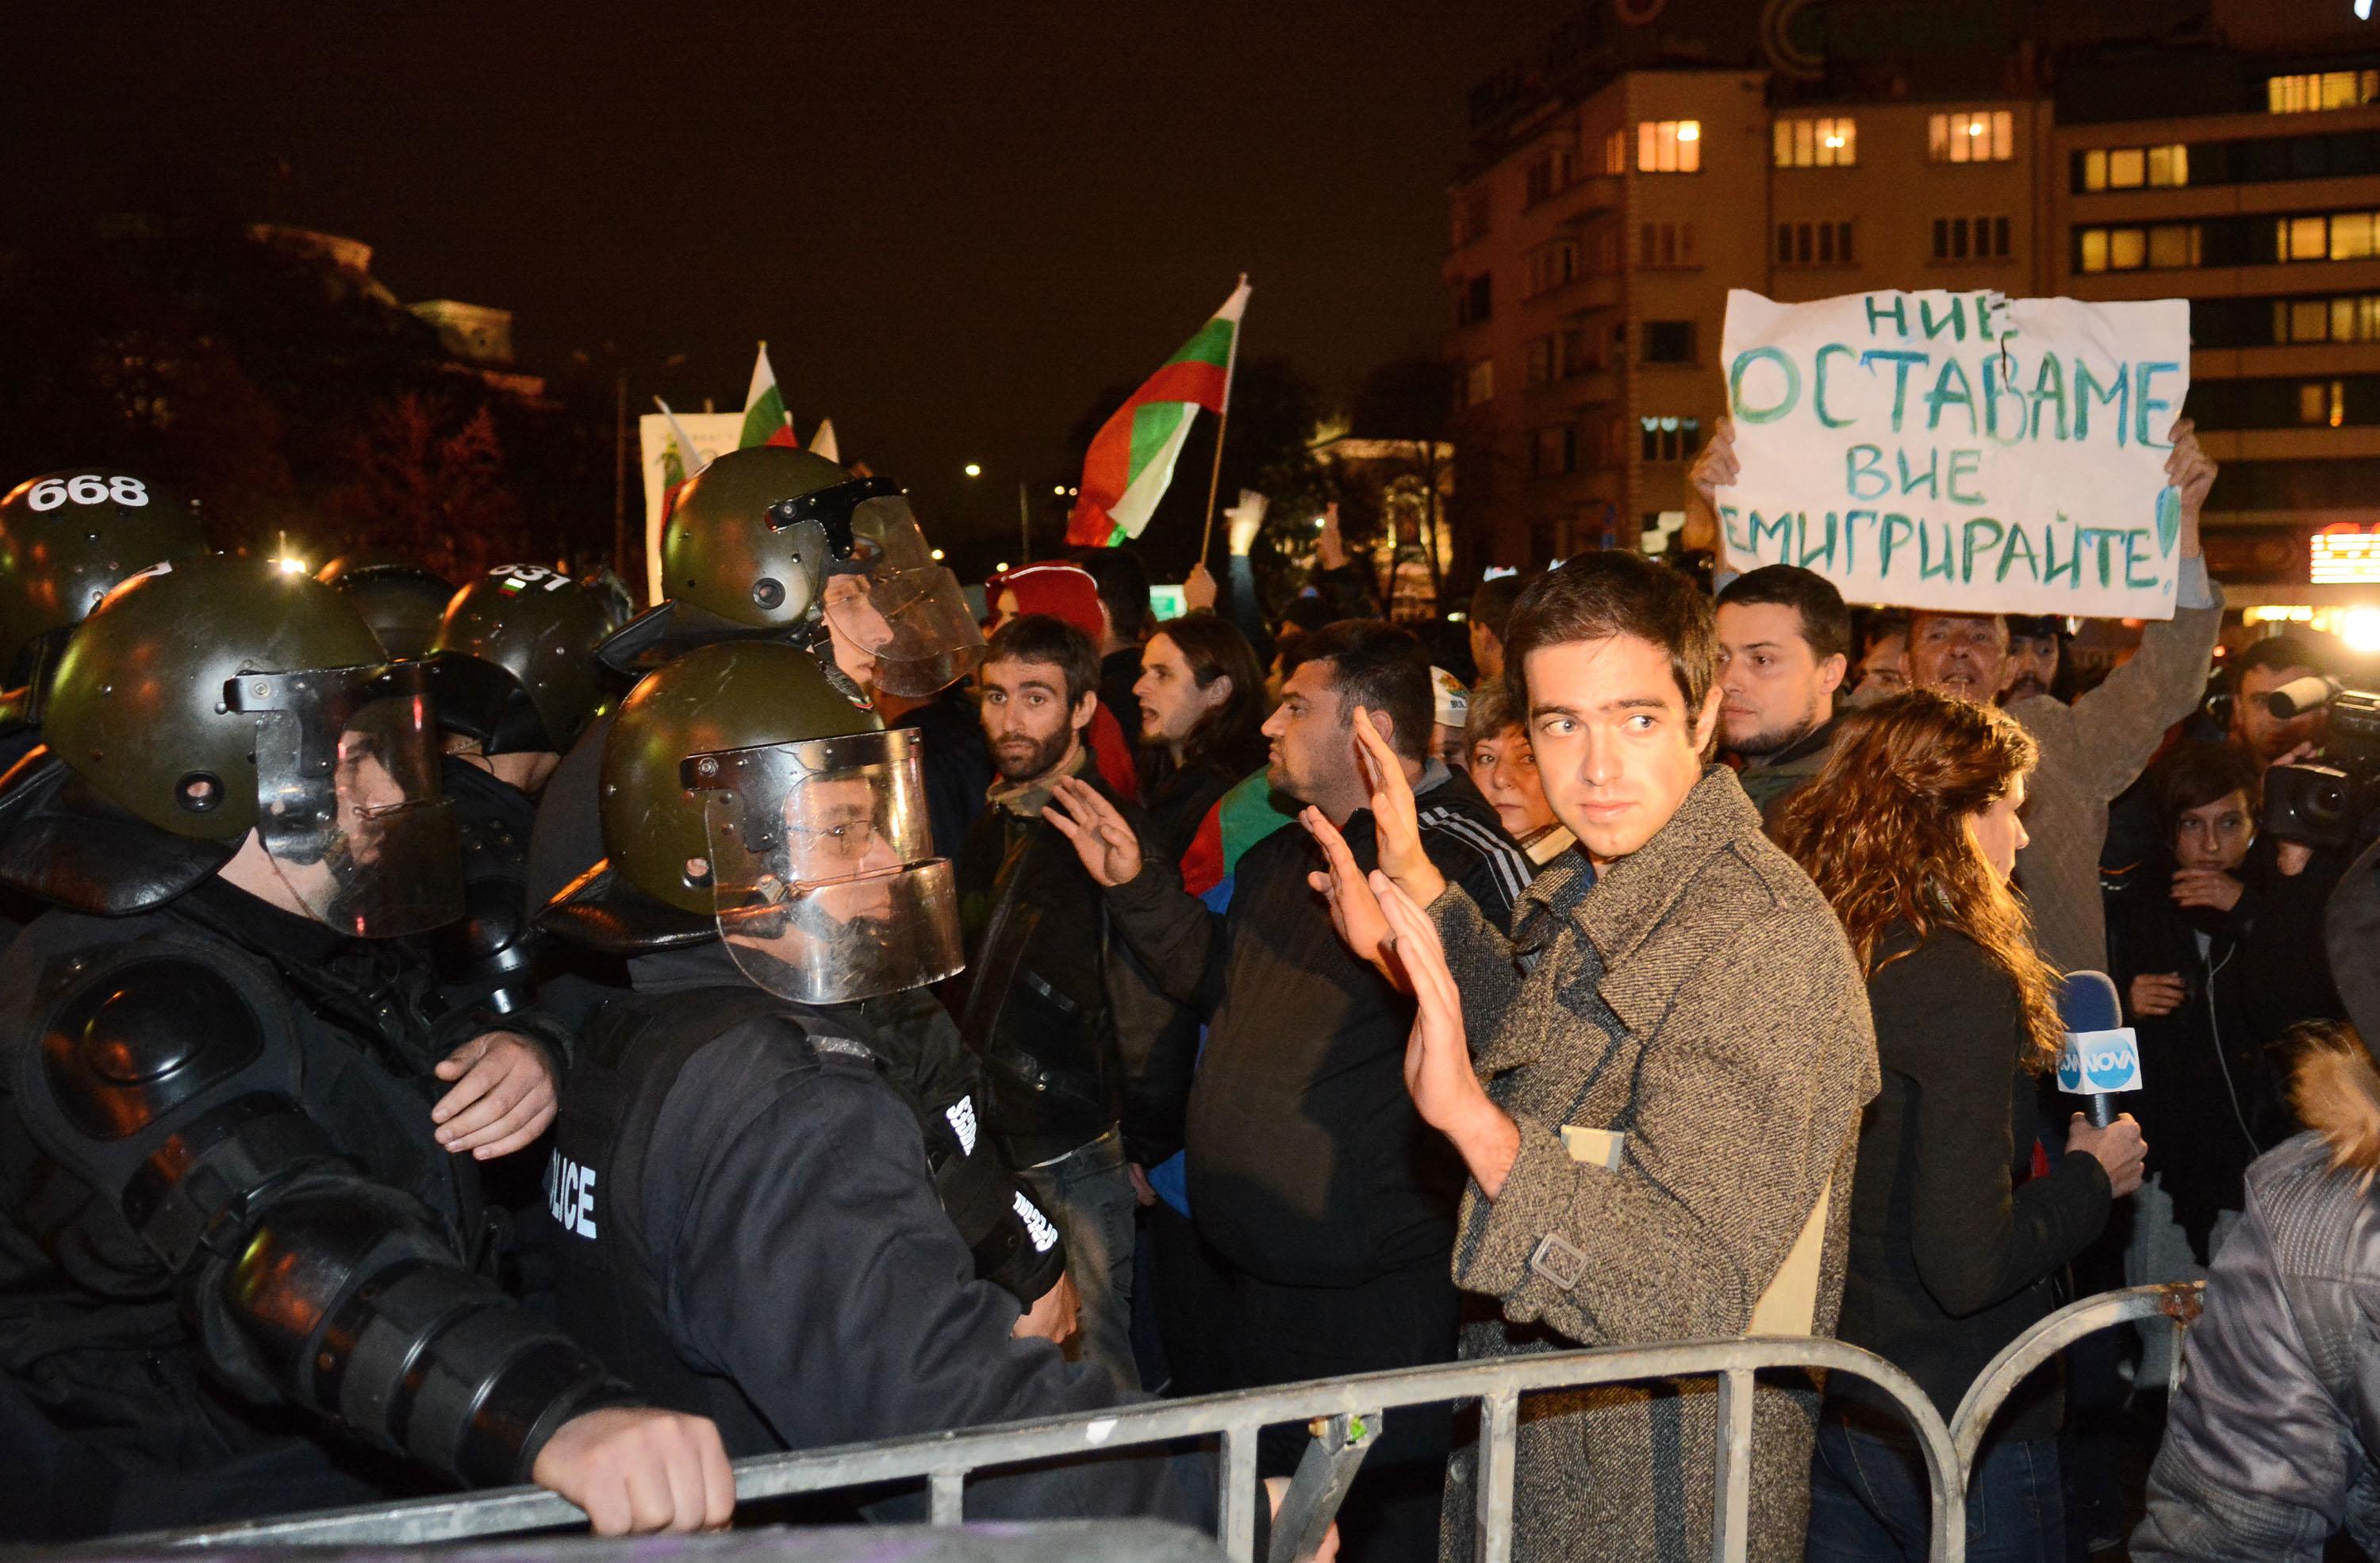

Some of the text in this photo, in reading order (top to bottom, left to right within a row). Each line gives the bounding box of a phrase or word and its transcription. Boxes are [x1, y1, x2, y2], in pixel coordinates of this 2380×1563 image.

[1865, 295, 2019, 342] НИЕ
[1729, 343, 2180, 449] ОСТАВАМЕ
[28, 474, 150, 512] 668
[1846, 444, 1987, 505] ВИЕ
[2083, 1050, 2136, 1073] NOVA
[549, 1146, 597, 1239] LICE
